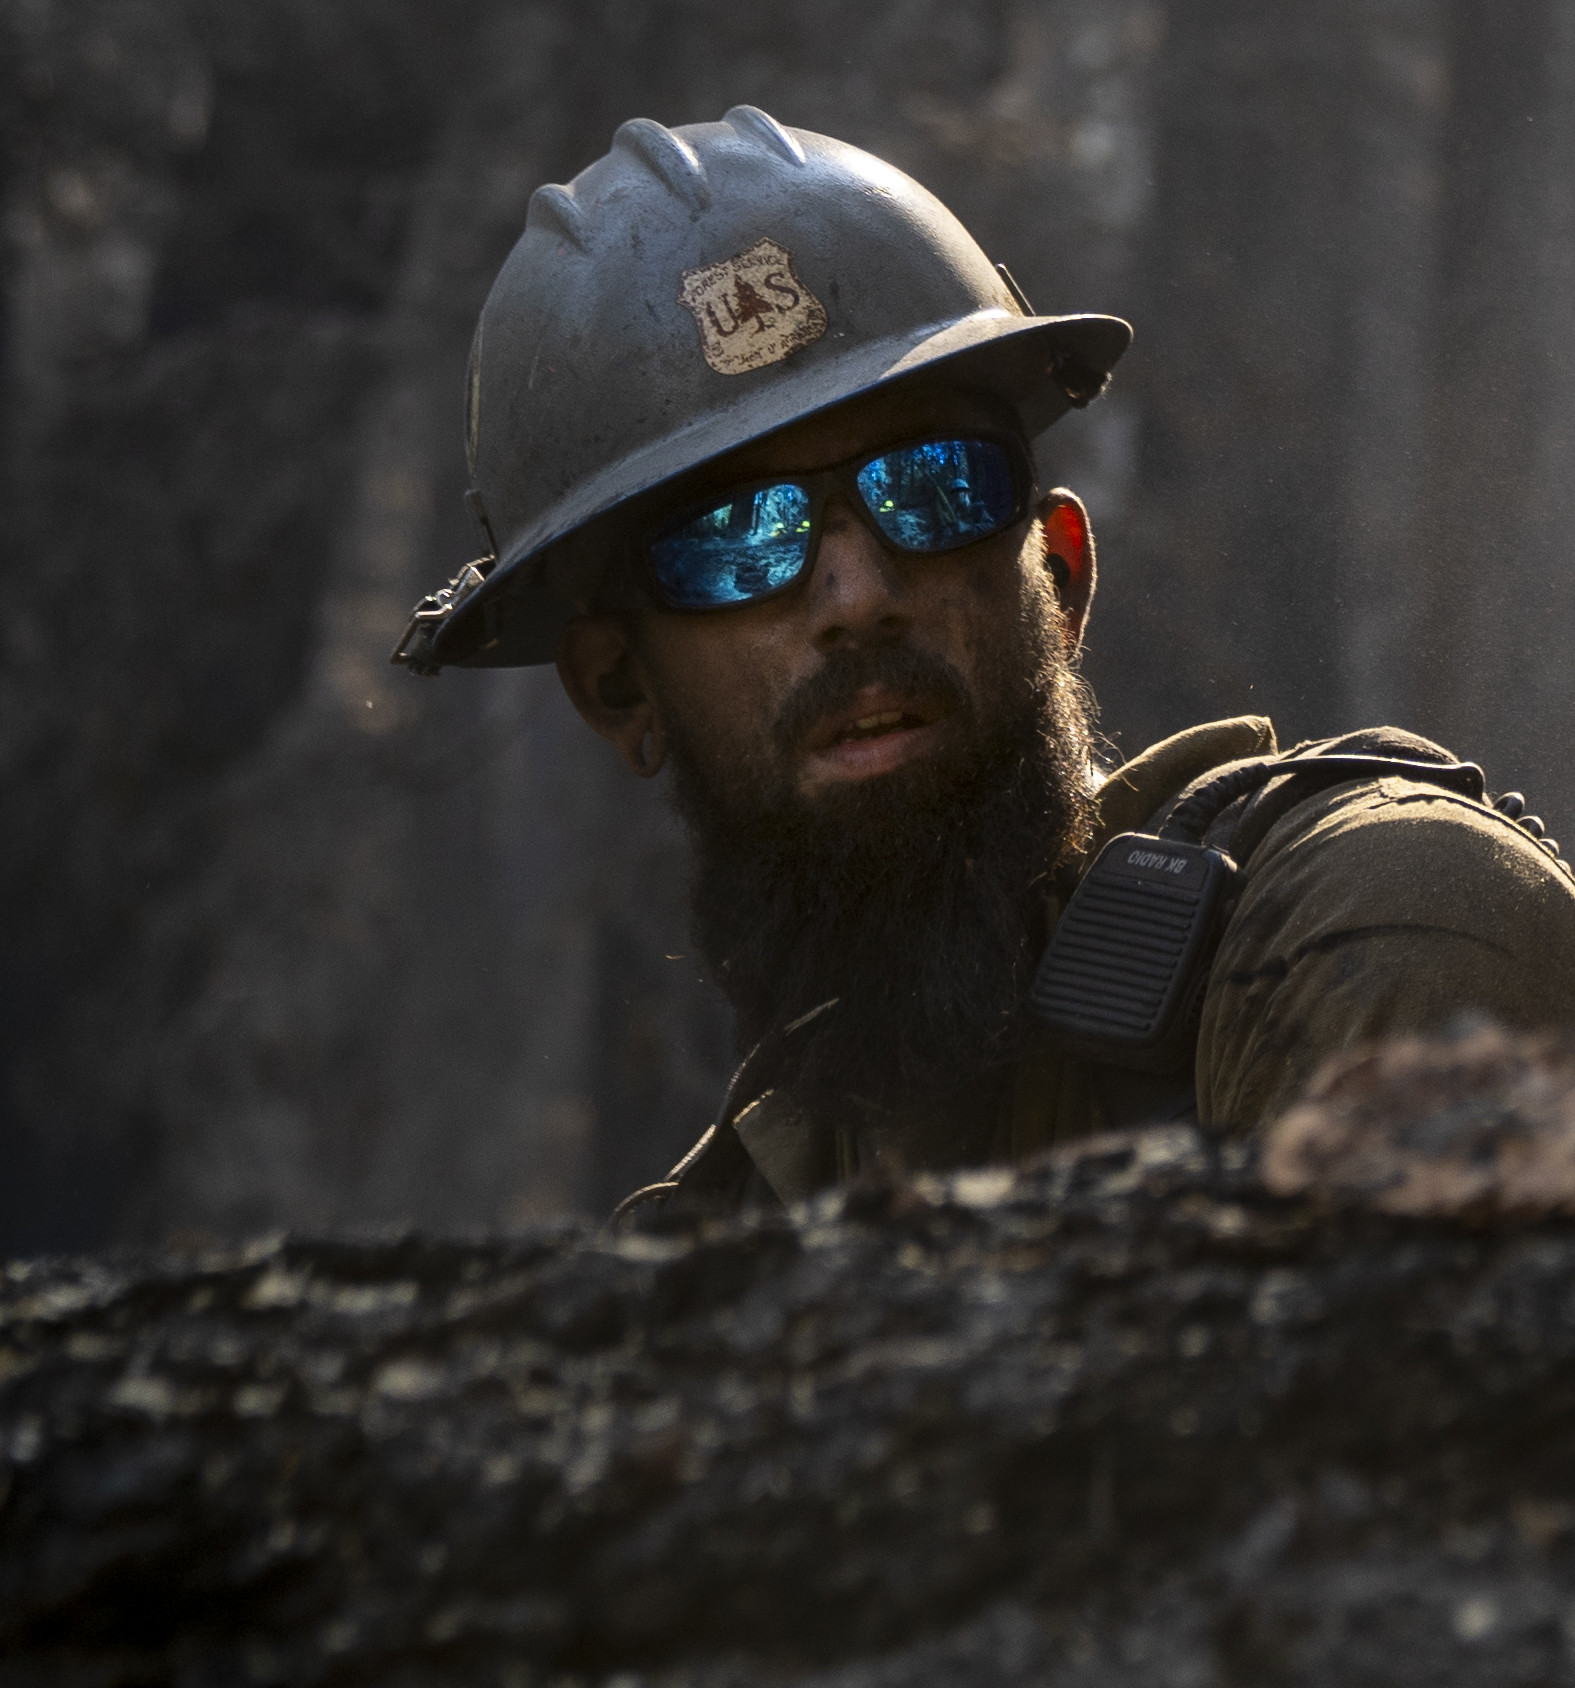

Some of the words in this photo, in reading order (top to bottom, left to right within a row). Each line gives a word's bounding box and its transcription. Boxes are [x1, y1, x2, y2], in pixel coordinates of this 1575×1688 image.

[691, 266, 729, 303] OREST
[706, 292, 741, 337] U
[764, 272, 801, 314] S
[1127, 850, 1168, 870] RADIO
[1165, 857, 1188, 874] BK
